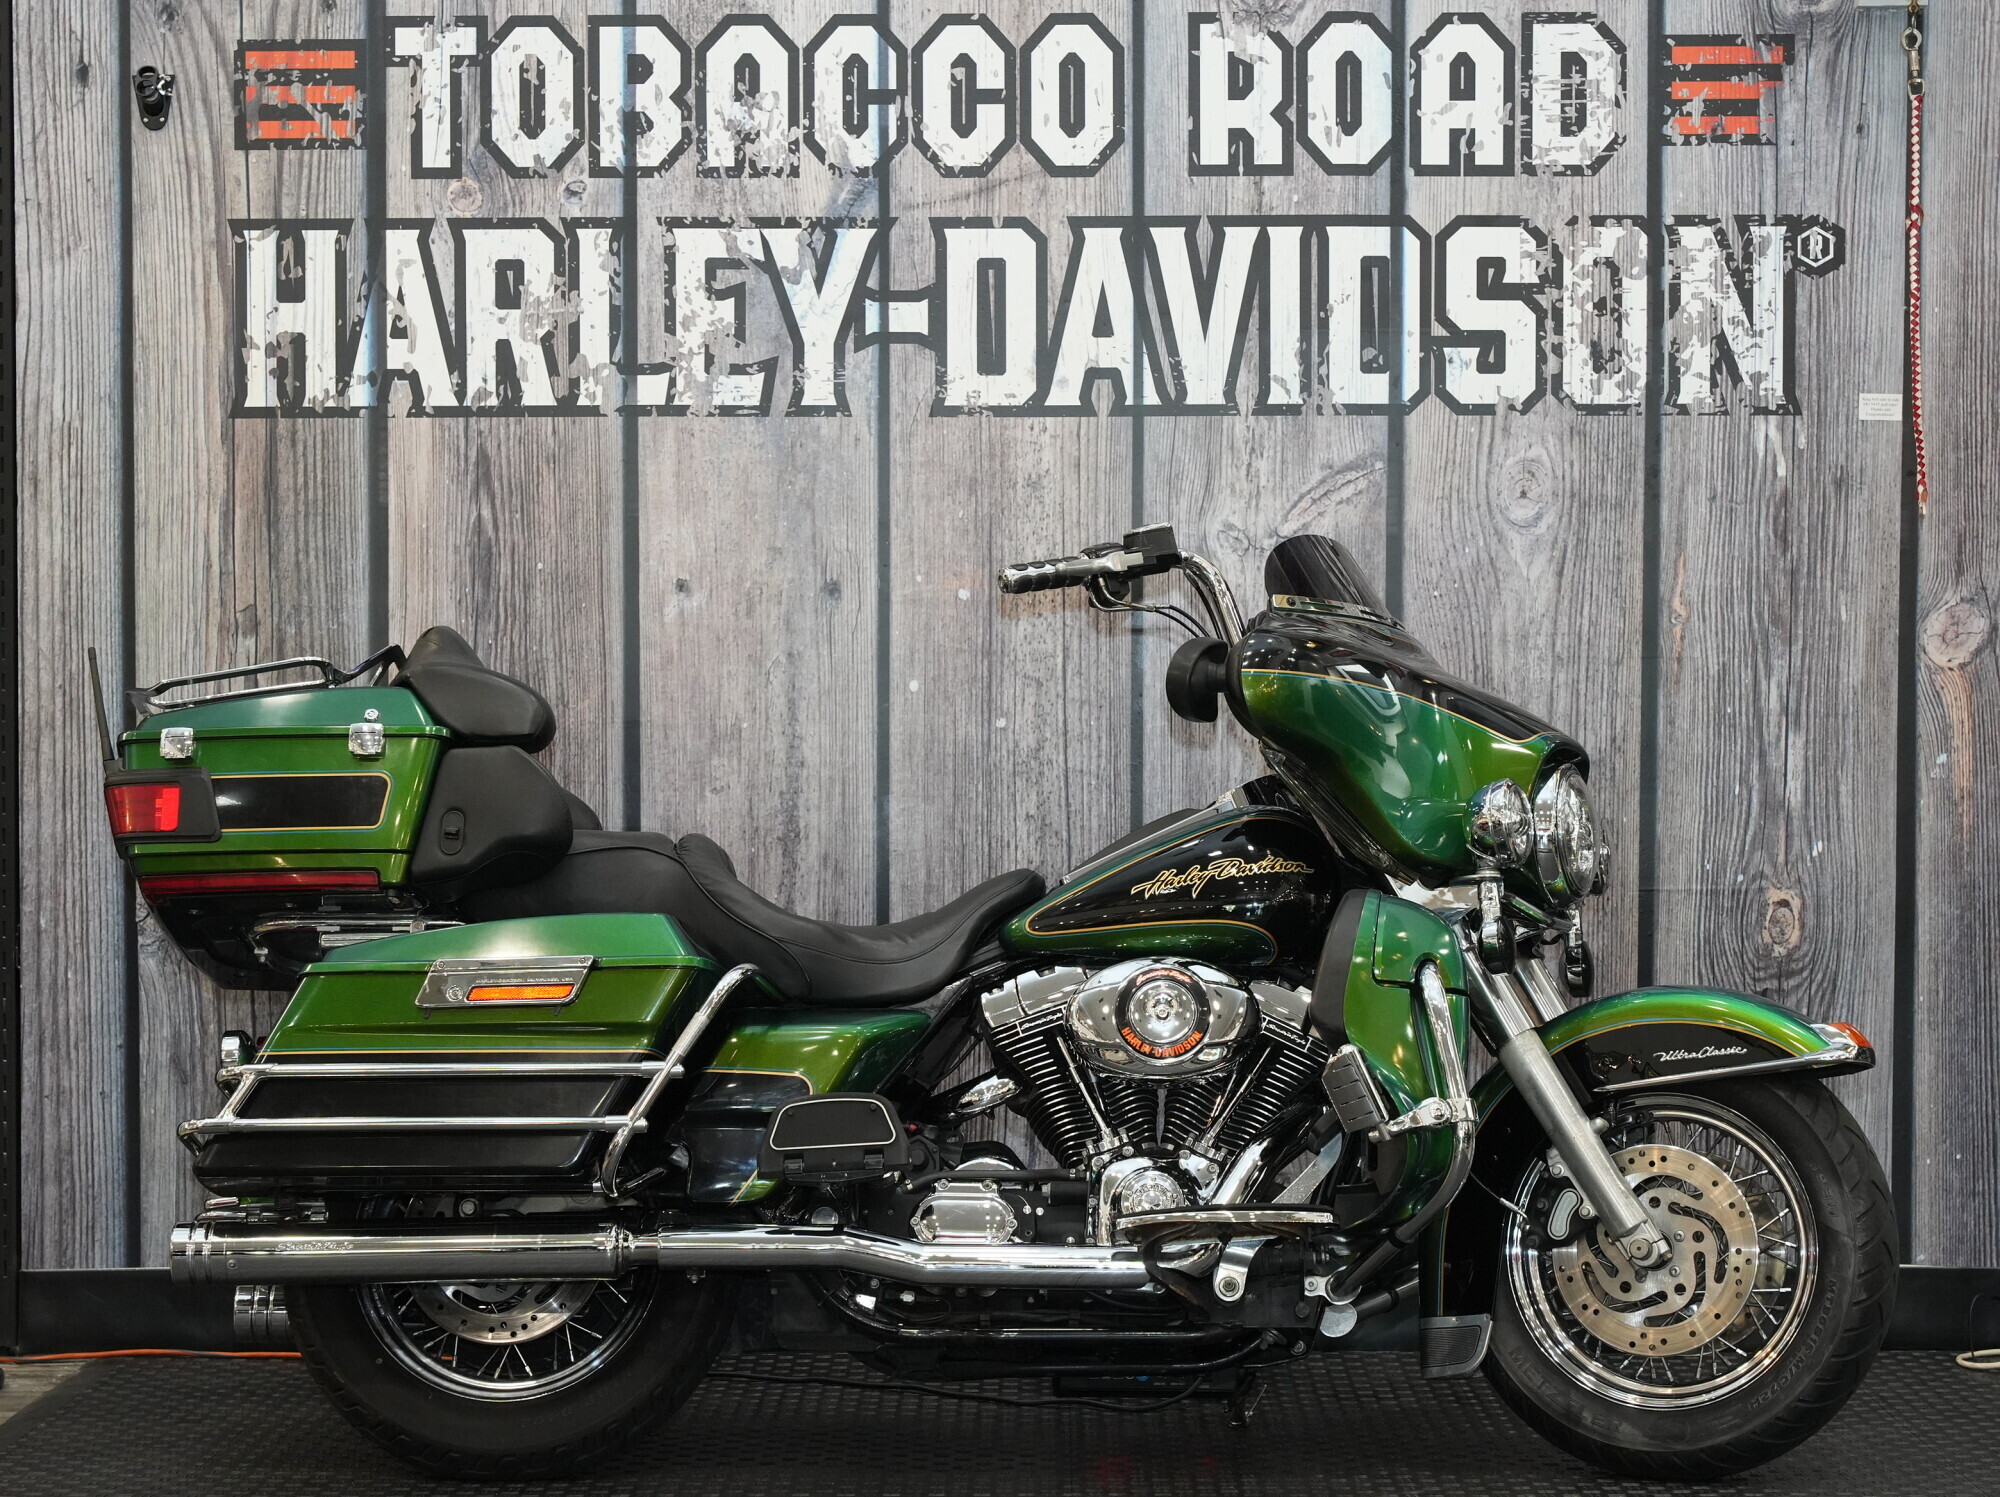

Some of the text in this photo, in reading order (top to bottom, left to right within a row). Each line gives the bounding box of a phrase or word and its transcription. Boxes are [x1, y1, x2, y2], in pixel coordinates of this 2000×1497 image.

[385, 11, 1628, 179] TOBACCO ROAD
[228, 215, 1802, 417] HARLEY-DAVIDSON
[1131, 857, 1314, 899] Harley-Davidson
